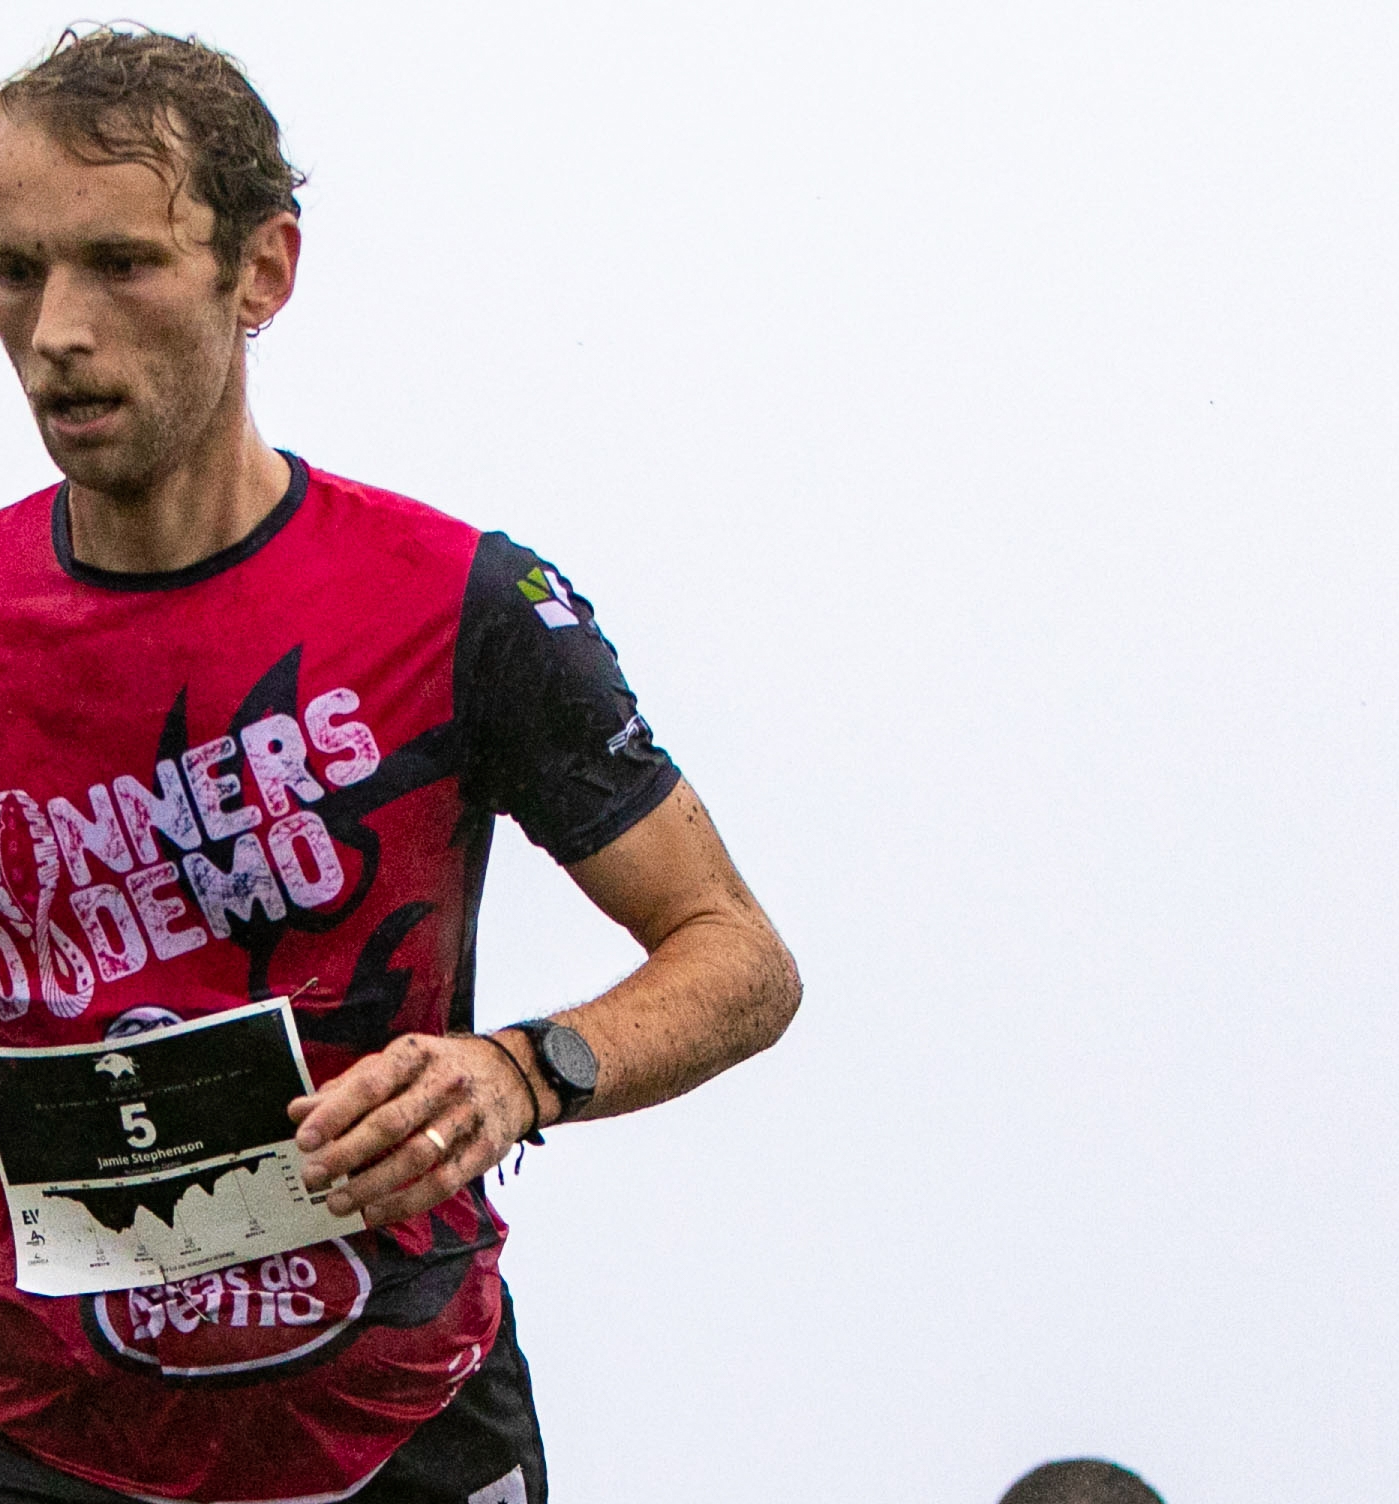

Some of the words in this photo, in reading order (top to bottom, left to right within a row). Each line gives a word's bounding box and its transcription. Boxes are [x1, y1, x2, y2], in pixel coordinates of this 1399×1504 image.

[120, 1102, 157, 1149] 5
[97, 1153, 130, 1170] Jamie
[131, 1140, 204, 1164] Stephenson
[260, 1255, 317, 1292] do
